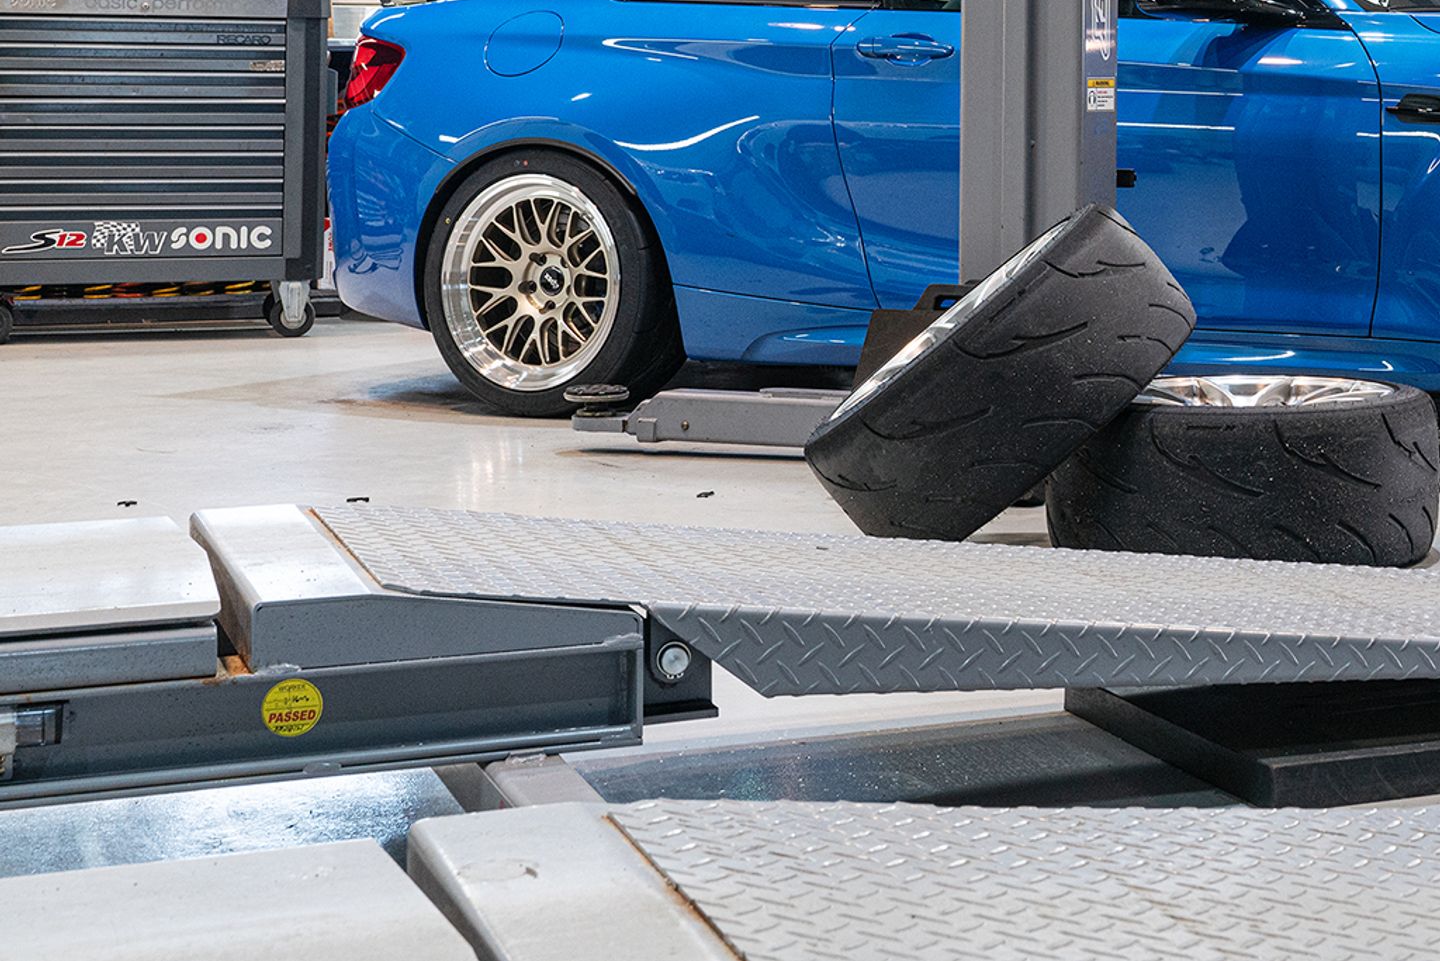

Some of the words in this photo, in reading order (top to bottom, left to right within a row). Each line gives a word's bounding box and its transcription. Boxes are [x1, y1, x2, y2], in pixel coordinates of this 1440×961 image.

[216, 34, 272, 46] RECARO
[2, 228, 87, 254] S12
[103, 230, 167, 255] KW
[268, 709, 317, 724] PASSED
